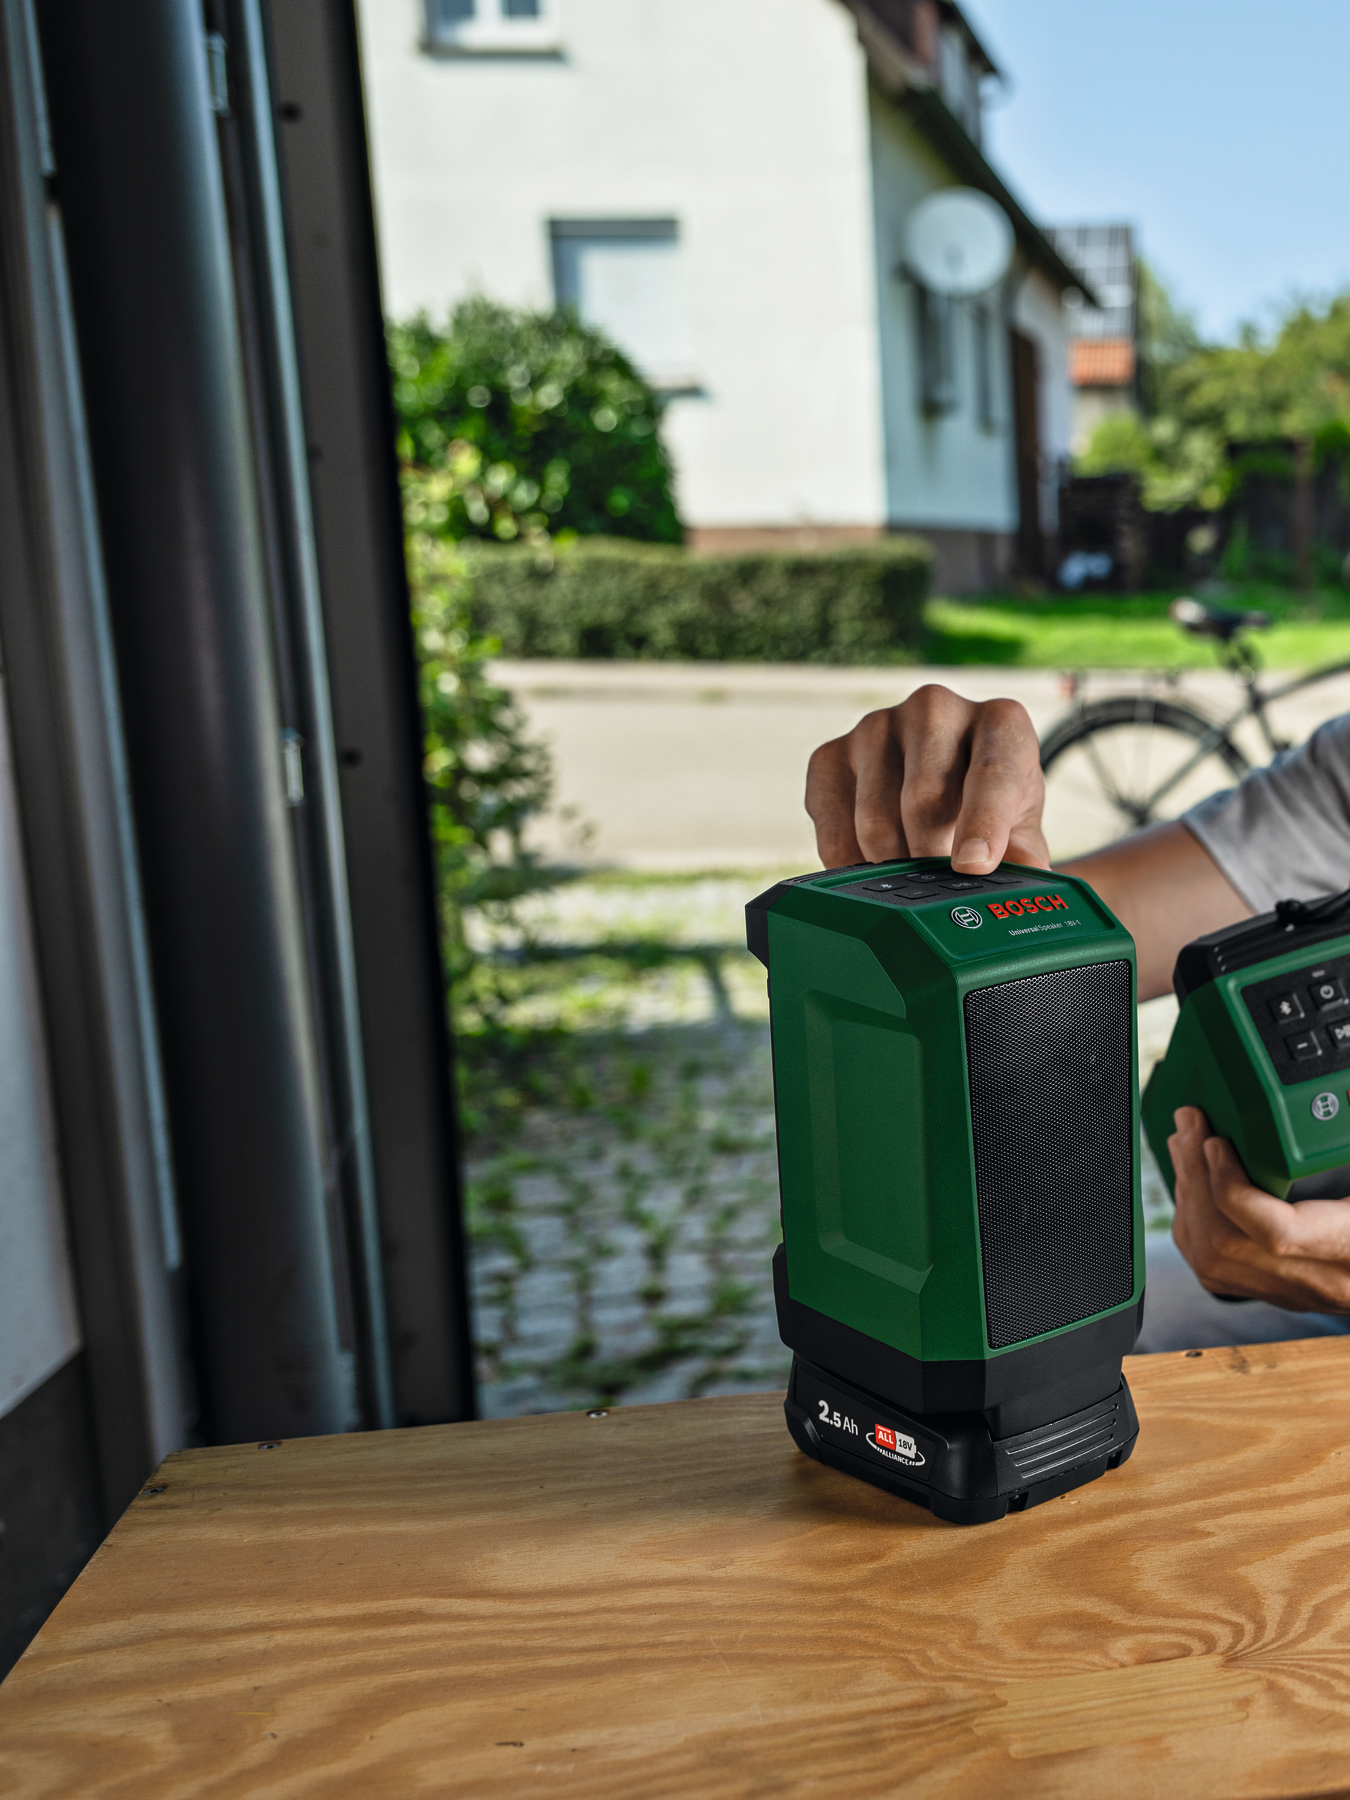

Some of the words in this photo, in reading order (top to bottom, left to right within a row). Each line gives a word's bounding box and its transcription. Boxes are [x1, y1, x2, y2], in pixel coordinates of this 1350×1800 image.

[987, 894, 1069, 918] BOSCH
[818, 1400, 842, 1428] 2.5
[843, 1416, 858, 1436] Ah
[878, 1430, 894, 1444] ALL
[898, 1438, 913, 1452] 18V
[882, 1449, 909, 1465] ALLIANCE
